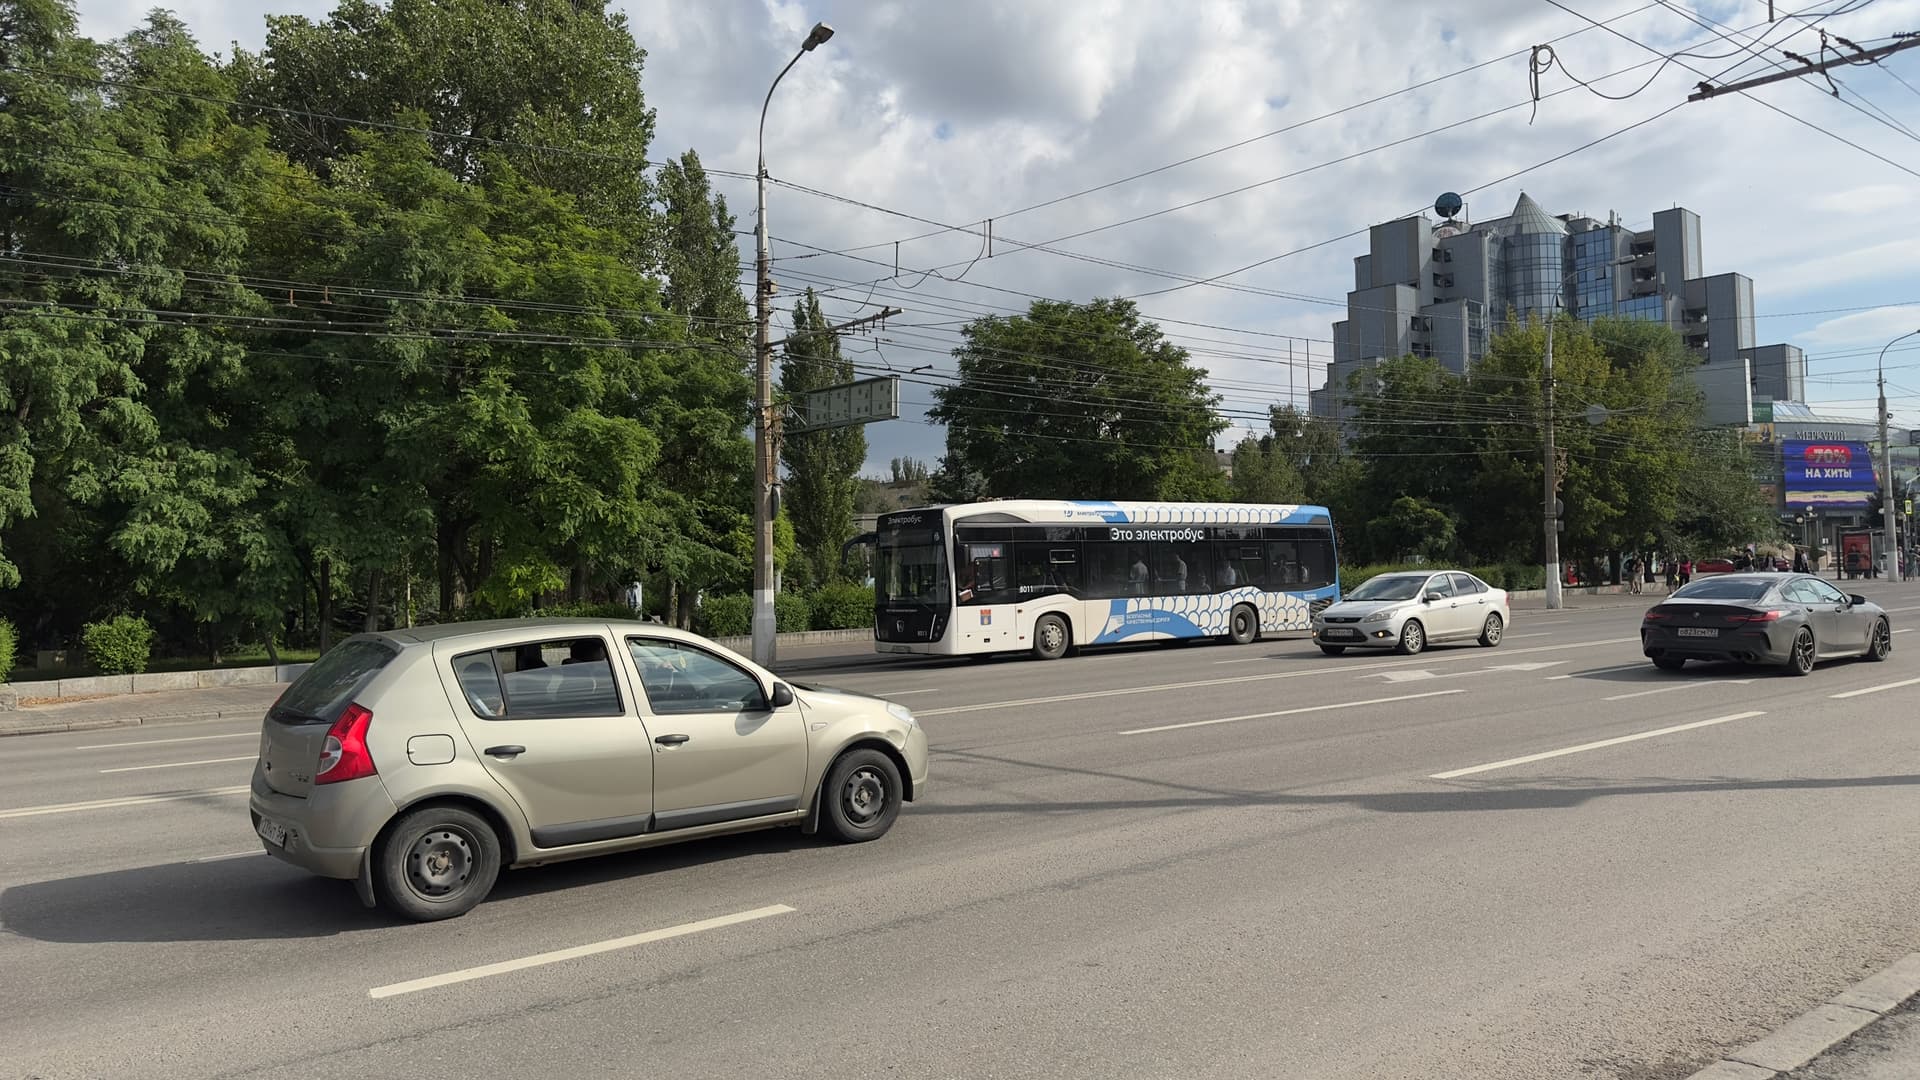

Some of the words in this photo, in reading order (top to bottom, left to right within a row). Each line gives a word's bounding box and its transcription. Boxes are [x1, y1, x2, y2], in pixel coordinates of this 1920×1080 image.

[1805, 468, 1822, 478] НА
[1824, 468, 1852, 478] ХИТЫ
[887, 514, 922, 525] Электробус
[1111, 528, 1133, 541] Это
[1136, 528, 1205, 543] электробус
[1019, 585, 1034, 593] 8011
